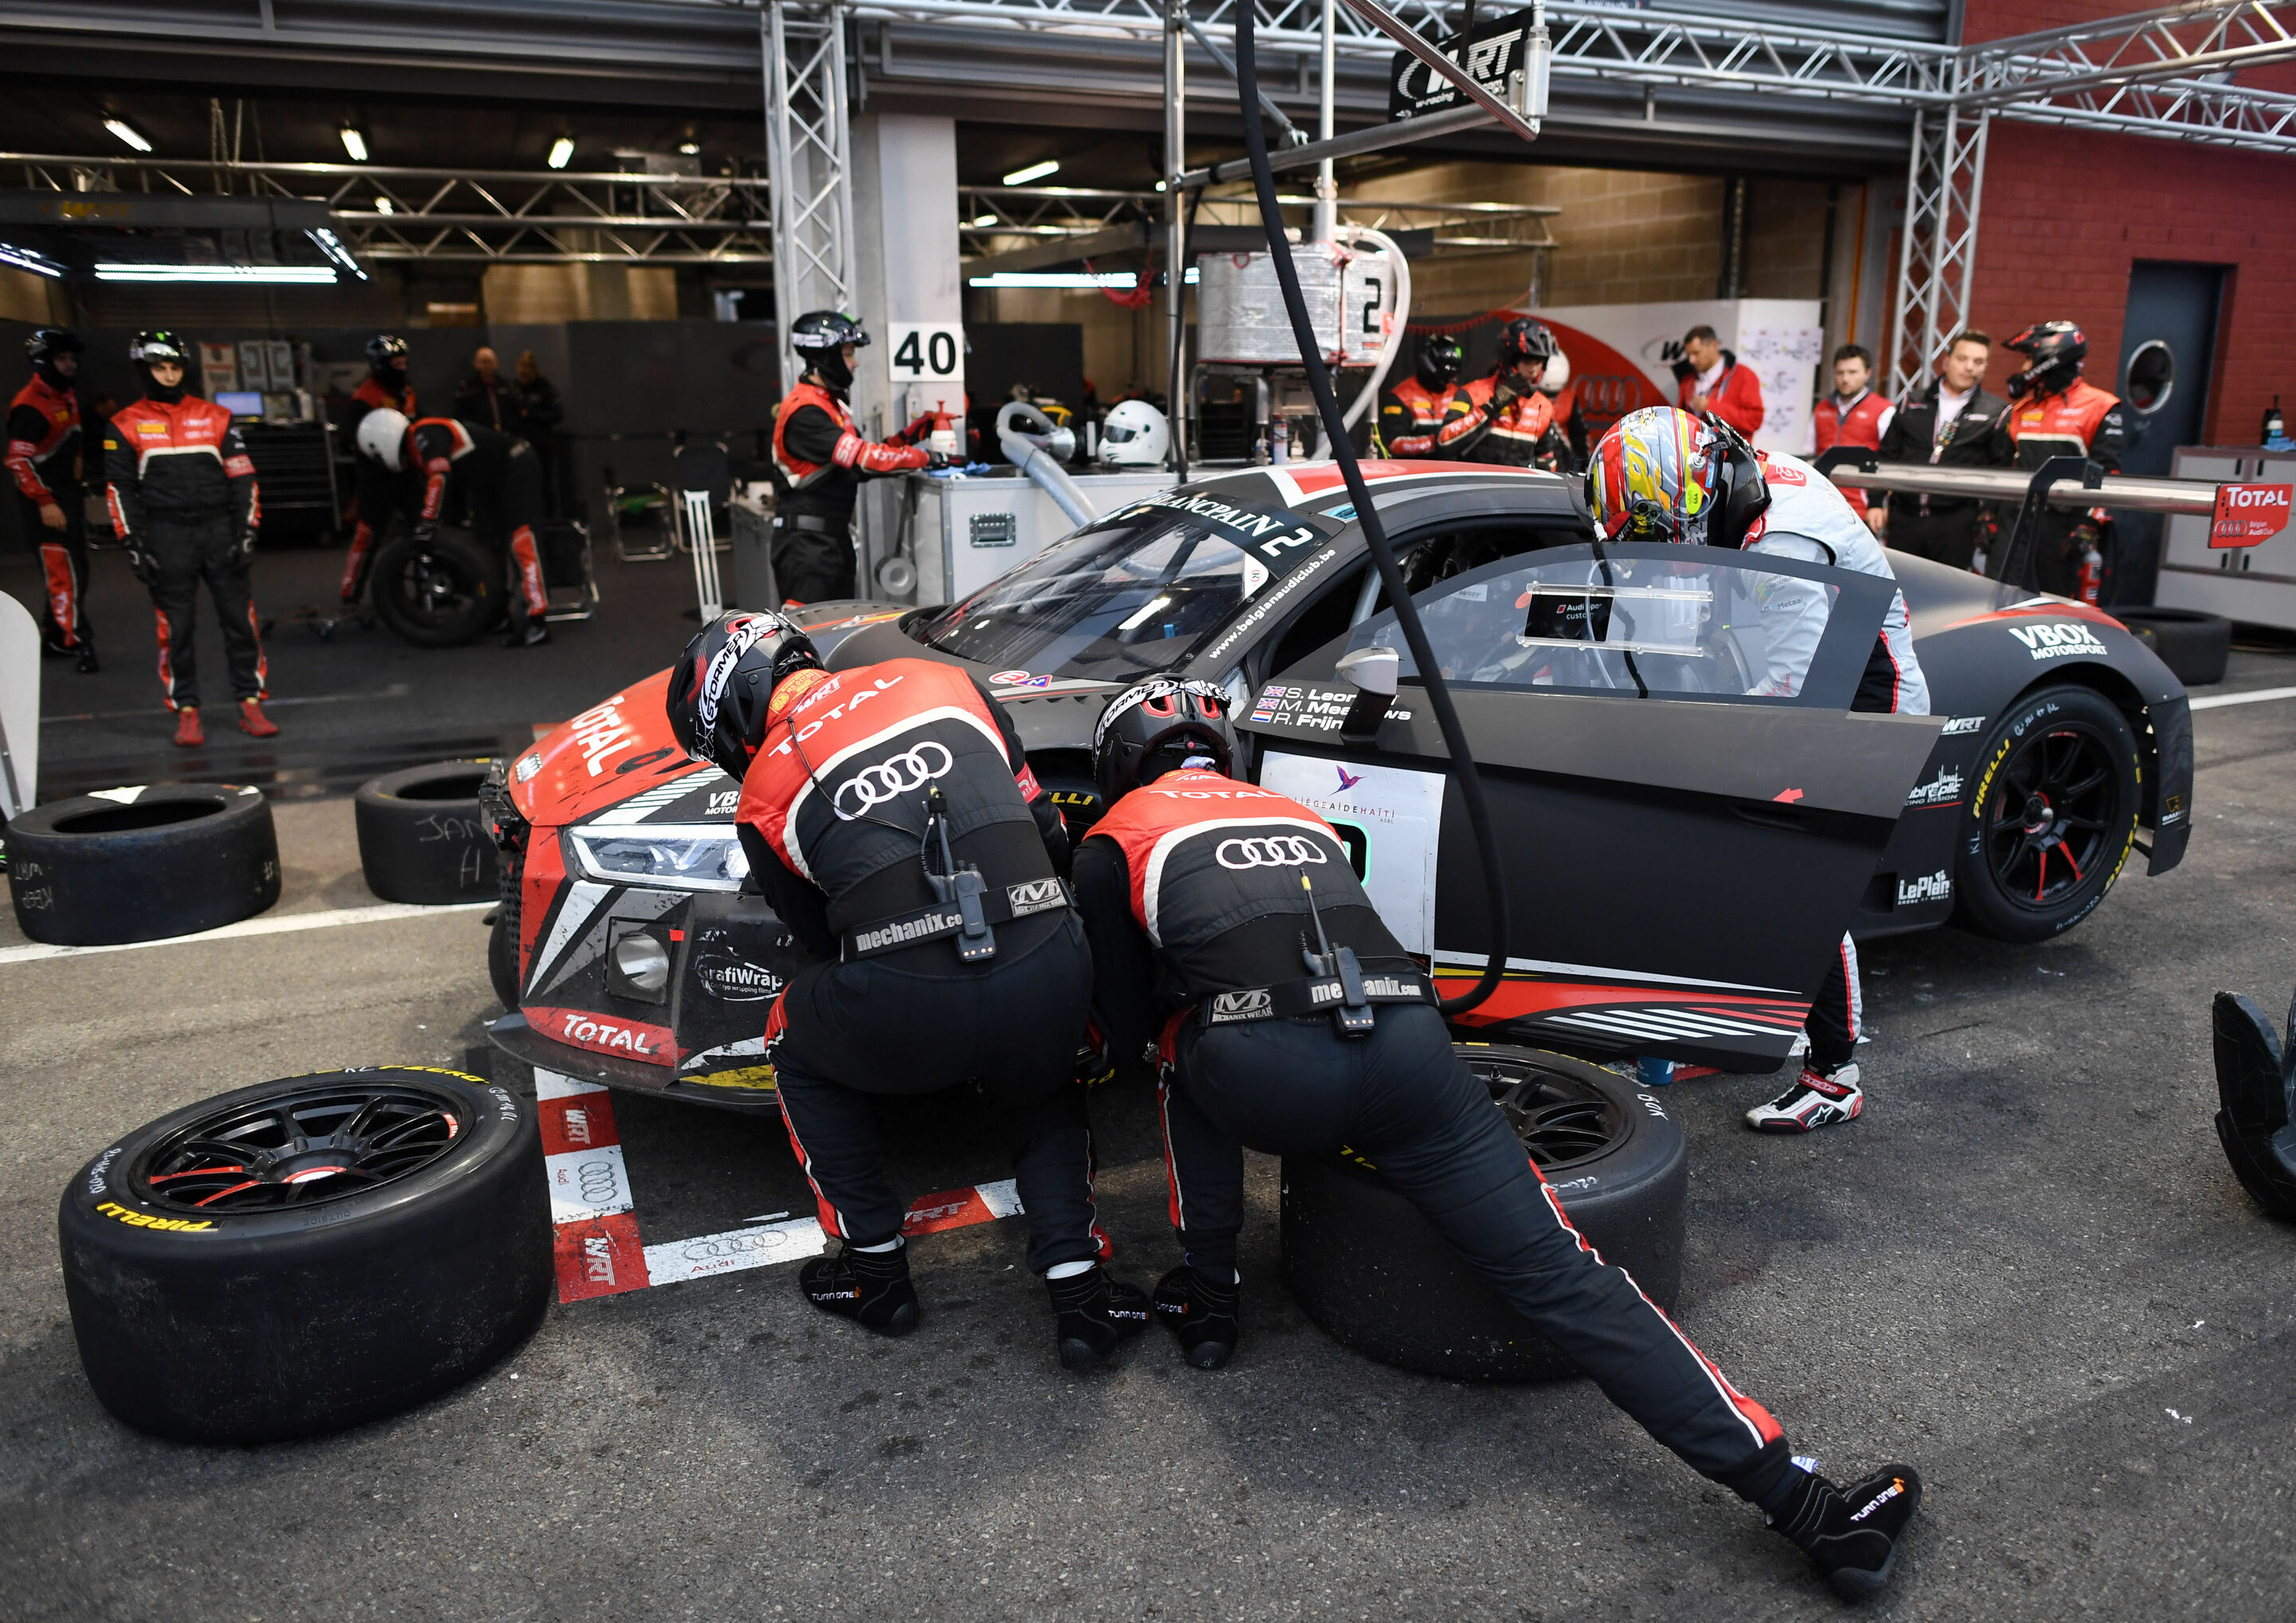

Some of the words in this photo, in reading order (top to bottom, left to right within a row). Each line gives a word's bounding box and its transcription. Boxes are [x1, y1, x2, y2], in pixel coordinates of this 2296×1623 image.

[1363, 277, 1382, 334] 2
[894, 331, 957, 375] 40
[2227, 486, 2289, 508] TOTAL
[1152, 492, 1285, 537] BLANCPAIN
[1260, 527, 1314, 558] 2
[1209, 548, 1337, 661] www.belgianaudiclub.be
[1566, 603, 1585, 612] Audi
[2008, 623, 2102, 649] VBOX
[2030, 643, 2108, 660] MOTORSPORT
[706, 633, 744, 715] STORMER
[1278, 699, 1303, 712] M.
[1285, 687, 1304, 699] S.
[768, 674, 904, 757] TOTAL
[1273, 713, 1293, 726] R.
[1296, 714, 1344, 732] Frijn
[1942, 716, 1986, 732] WRT
[570, 694, 632, 778] TOTAL
[1972, 737, 2011, 819] PIRELLI
[1149, 790, 1287, 800] TOTAL
[855, 914, 964, 953] mechanix.co
[1311, 977, 1422, 1004] meanix.com
[563, 1013, 652, 1055] TOTAL
[565, 1109, 591, 1145] WRT
[557, 1169, 569, 1185] Audi
[96, 1201, 213, 1232] PIRELLI
[584, 1237, 615, 1286] WRT
[690, 1259, 735, 1274] Audi
[812, 1292, 835, 1301] TURN
[836, 1291, 855, 1299] ONE
[1132, 1311, 1146, 1320] ONE
[1850, 1499, 1880, 1522] TURN
[1876, 1486, 1899, 1503] ONE
